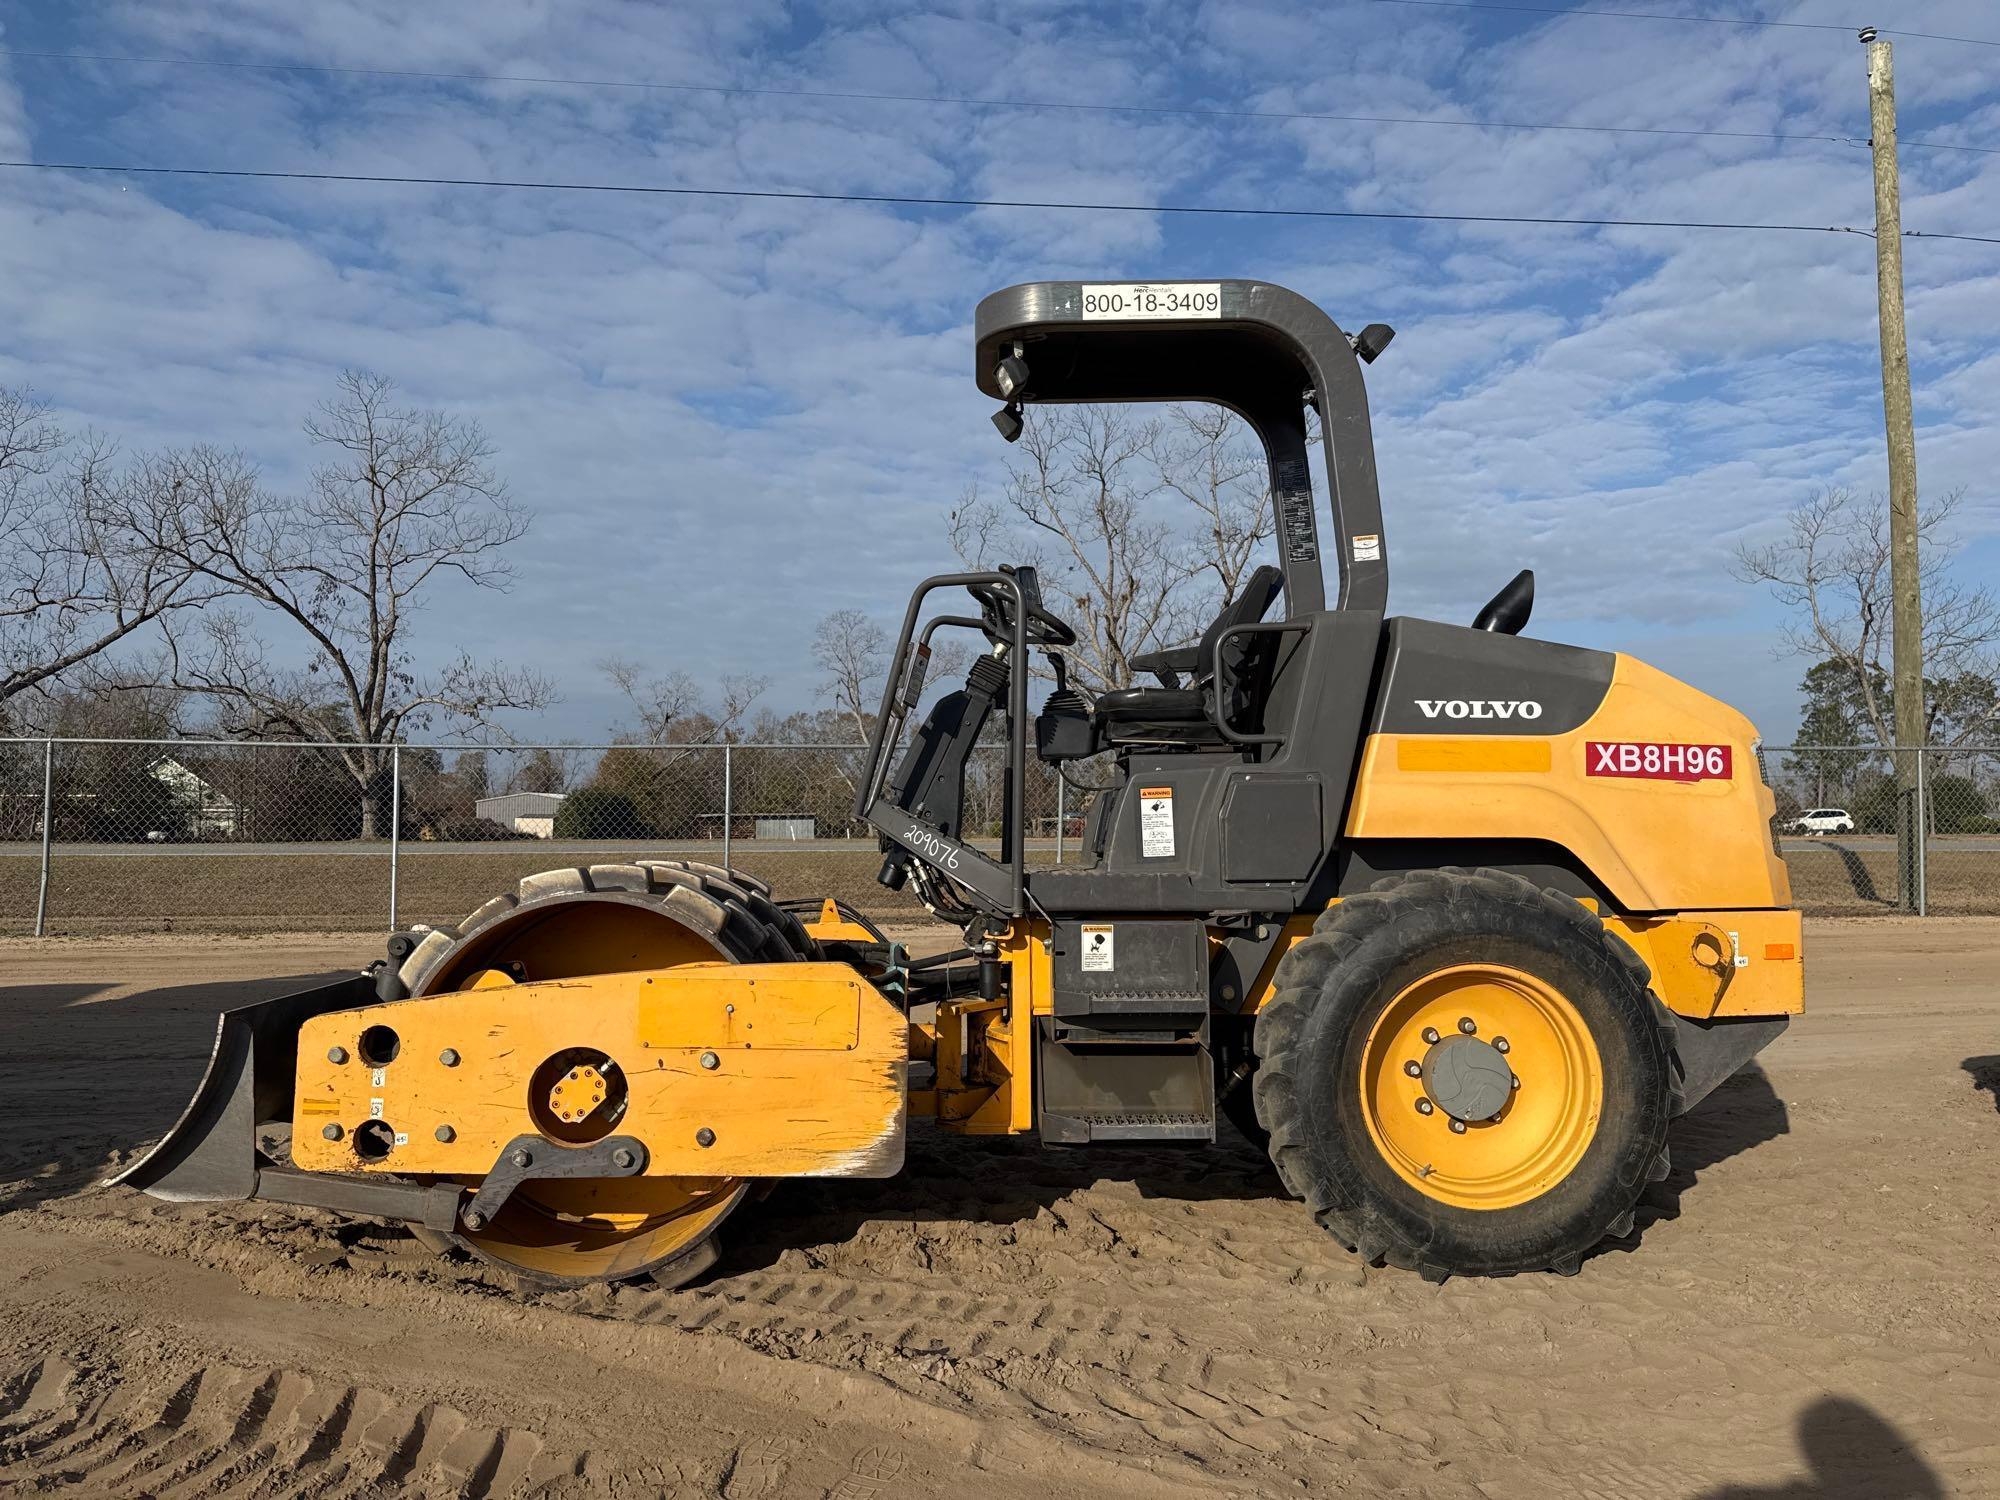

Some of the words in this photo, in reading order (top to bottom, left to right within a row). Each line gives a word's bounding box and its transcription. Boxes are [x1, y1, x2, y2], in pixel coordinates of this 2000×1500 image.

[1085, 293, 1218, 312] 800-18-3409
[1414, 699, 1542, 719] VOLVO
[1594, 743, 1725, 775] XB8H96
[903, 824, 959, 869] 209076
